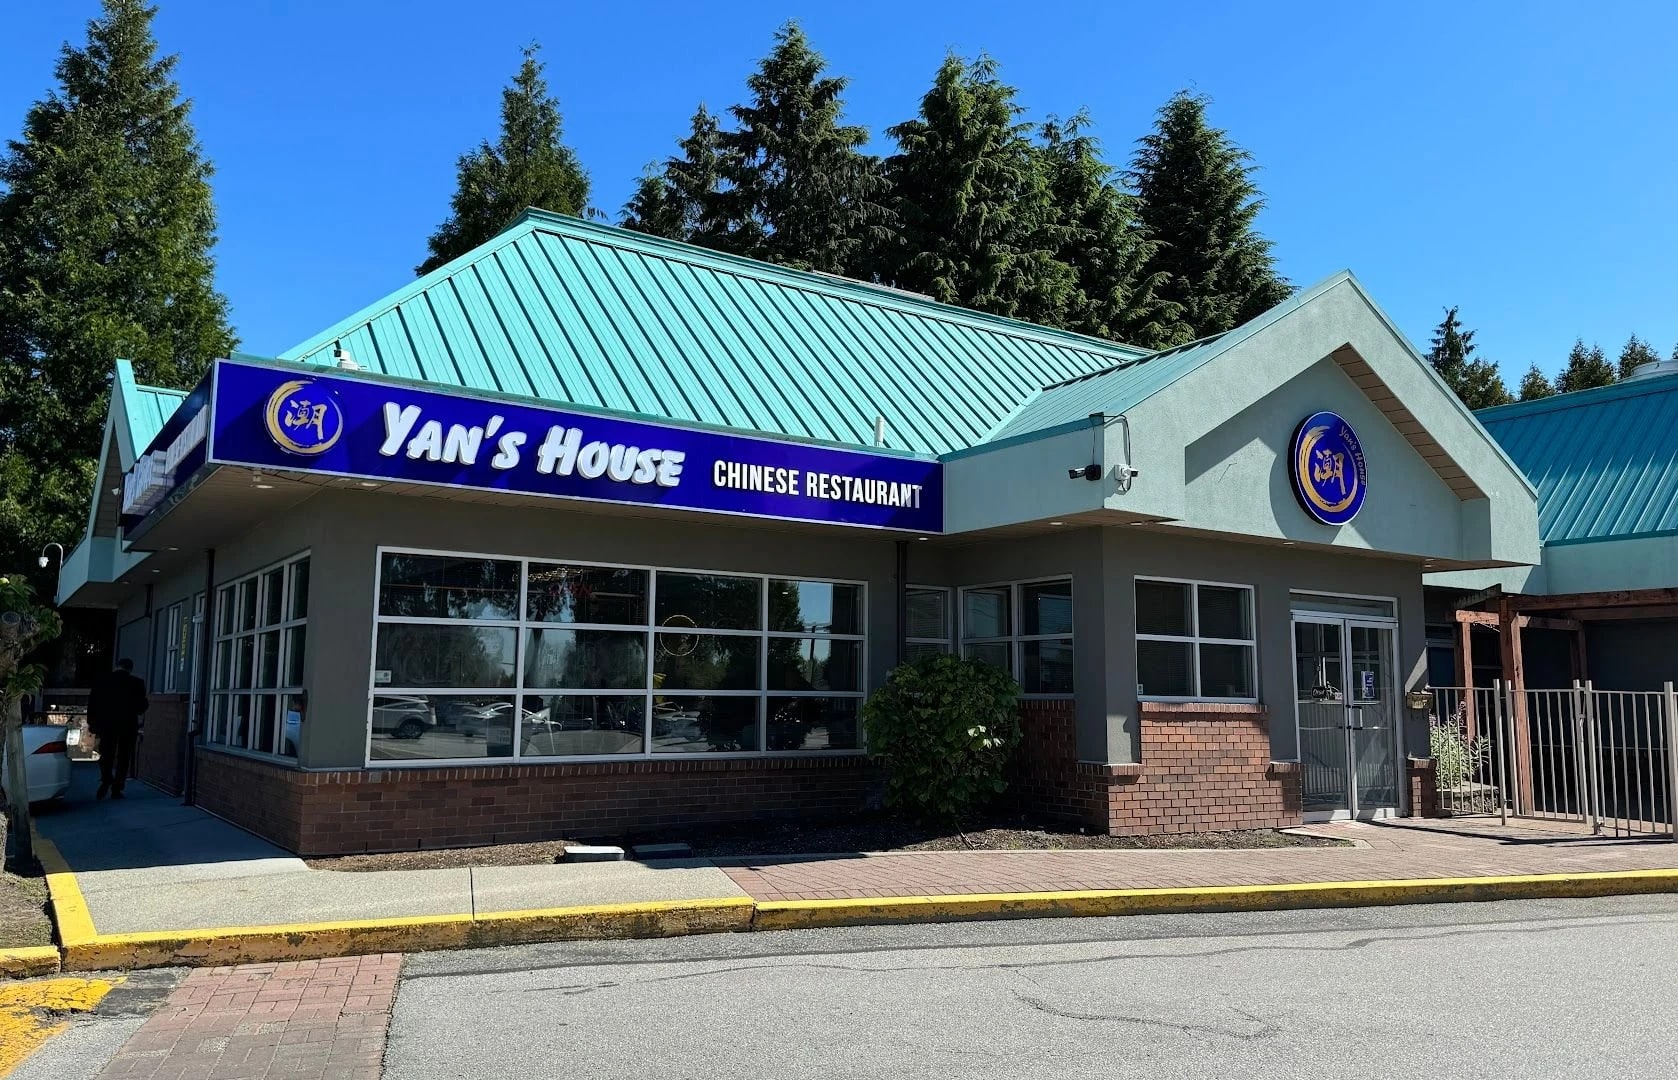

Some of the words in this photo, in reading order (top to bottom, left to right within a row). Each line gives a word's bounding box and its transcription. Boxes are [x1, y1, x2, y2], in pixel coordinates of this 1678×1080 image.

[284, 399, 328, 441] 潮
[379, 401, 527, 470] YAN'S
[536, 425, 686, 487] HOUSE
[713, 460, 799, 496] CHINESE
[806, 471, 922, 509] RESTAURANT
[1314, 448, 1346, 495] 潮
